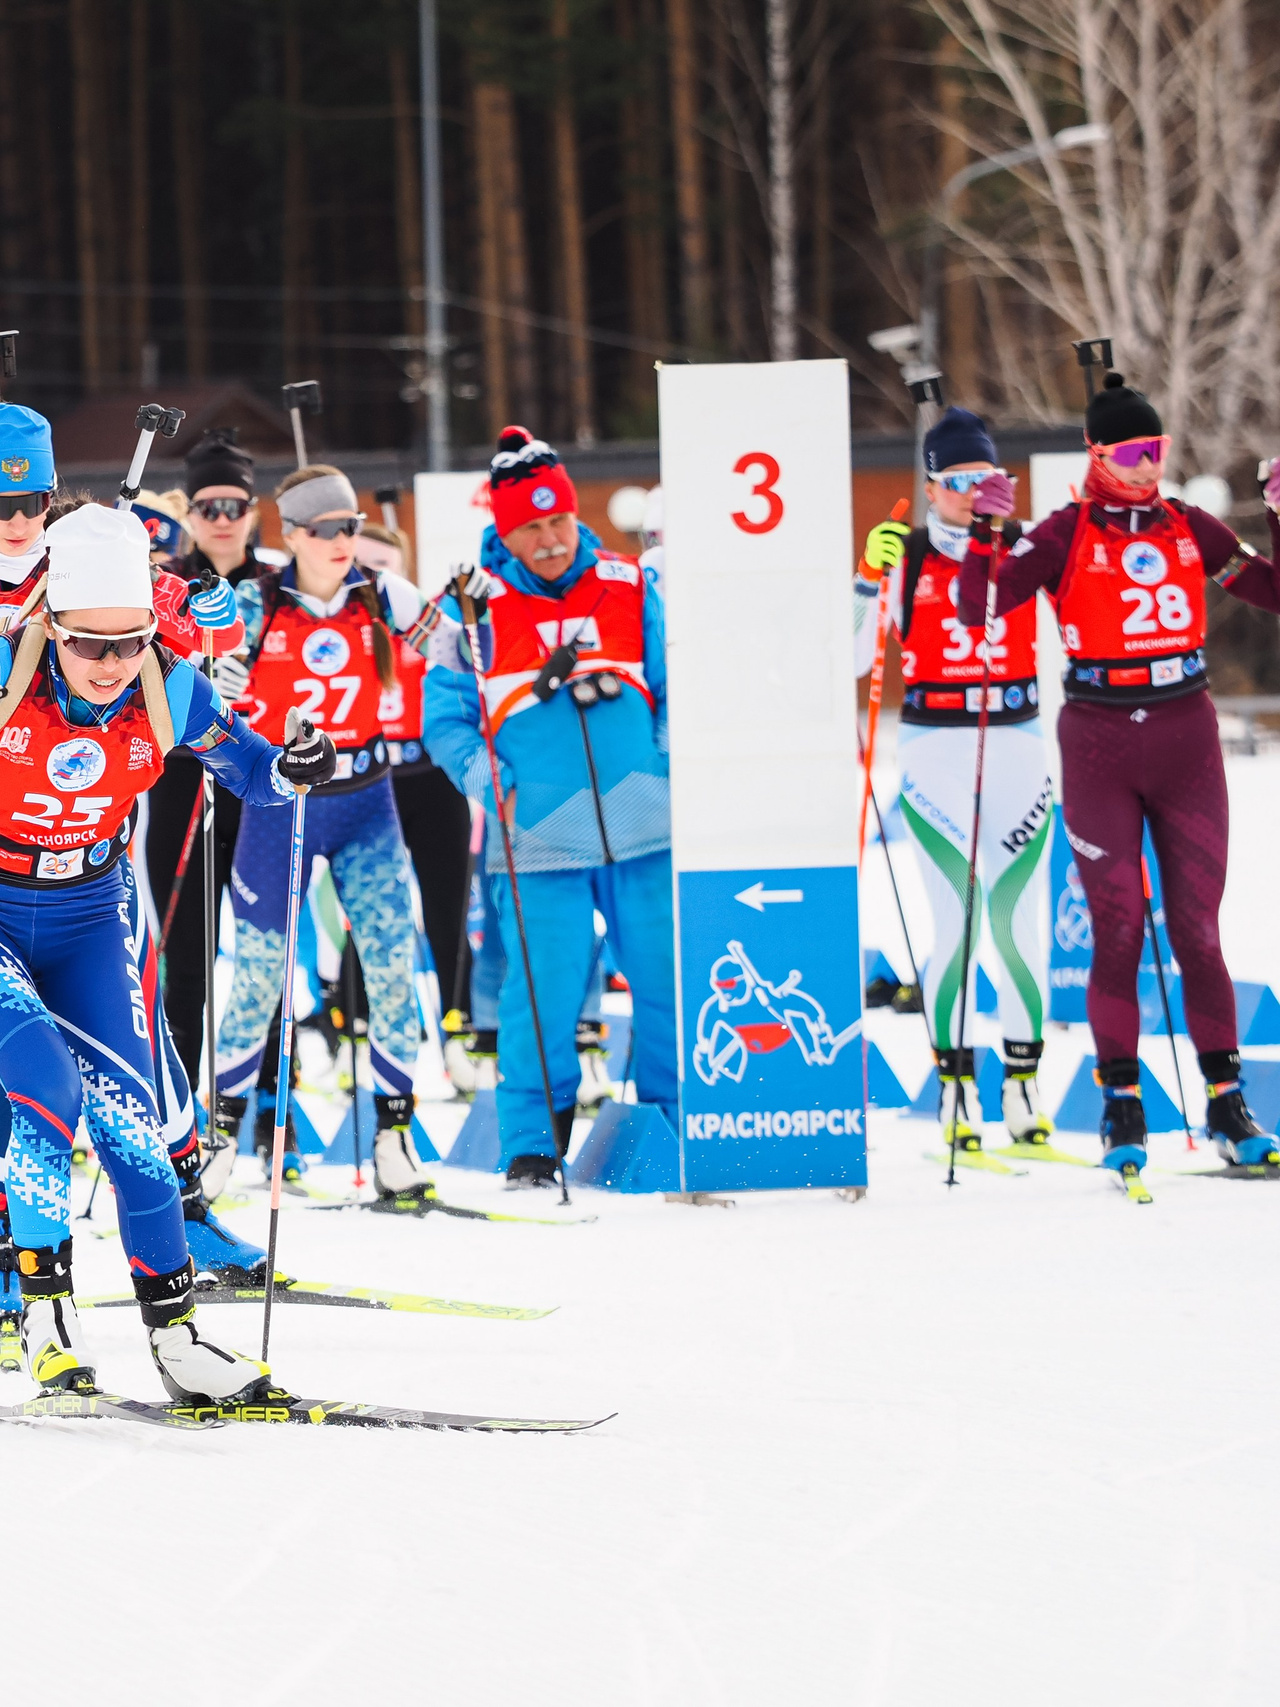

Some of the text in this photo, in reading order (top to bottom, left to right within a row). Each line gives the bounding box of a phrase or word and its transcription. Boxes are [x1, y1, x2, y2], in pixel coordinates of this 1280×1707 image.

[732, 452, 784, 534] 3
[1120, 584, 1193, 635] 28
[941, 616, 1008, 662] 32
[293, 676, 361, 724] 27
[11, 792, 113, 830] 25
[686, 1109, 863, 1140] КРАСНОЯРСК
[180, 1152, 198, 1170] 176
[167, 1272, 190, 1291] 175
[235, 1290, 267, 1299] FISCHE
[23, 1396, 82, 1416] FISCHER
